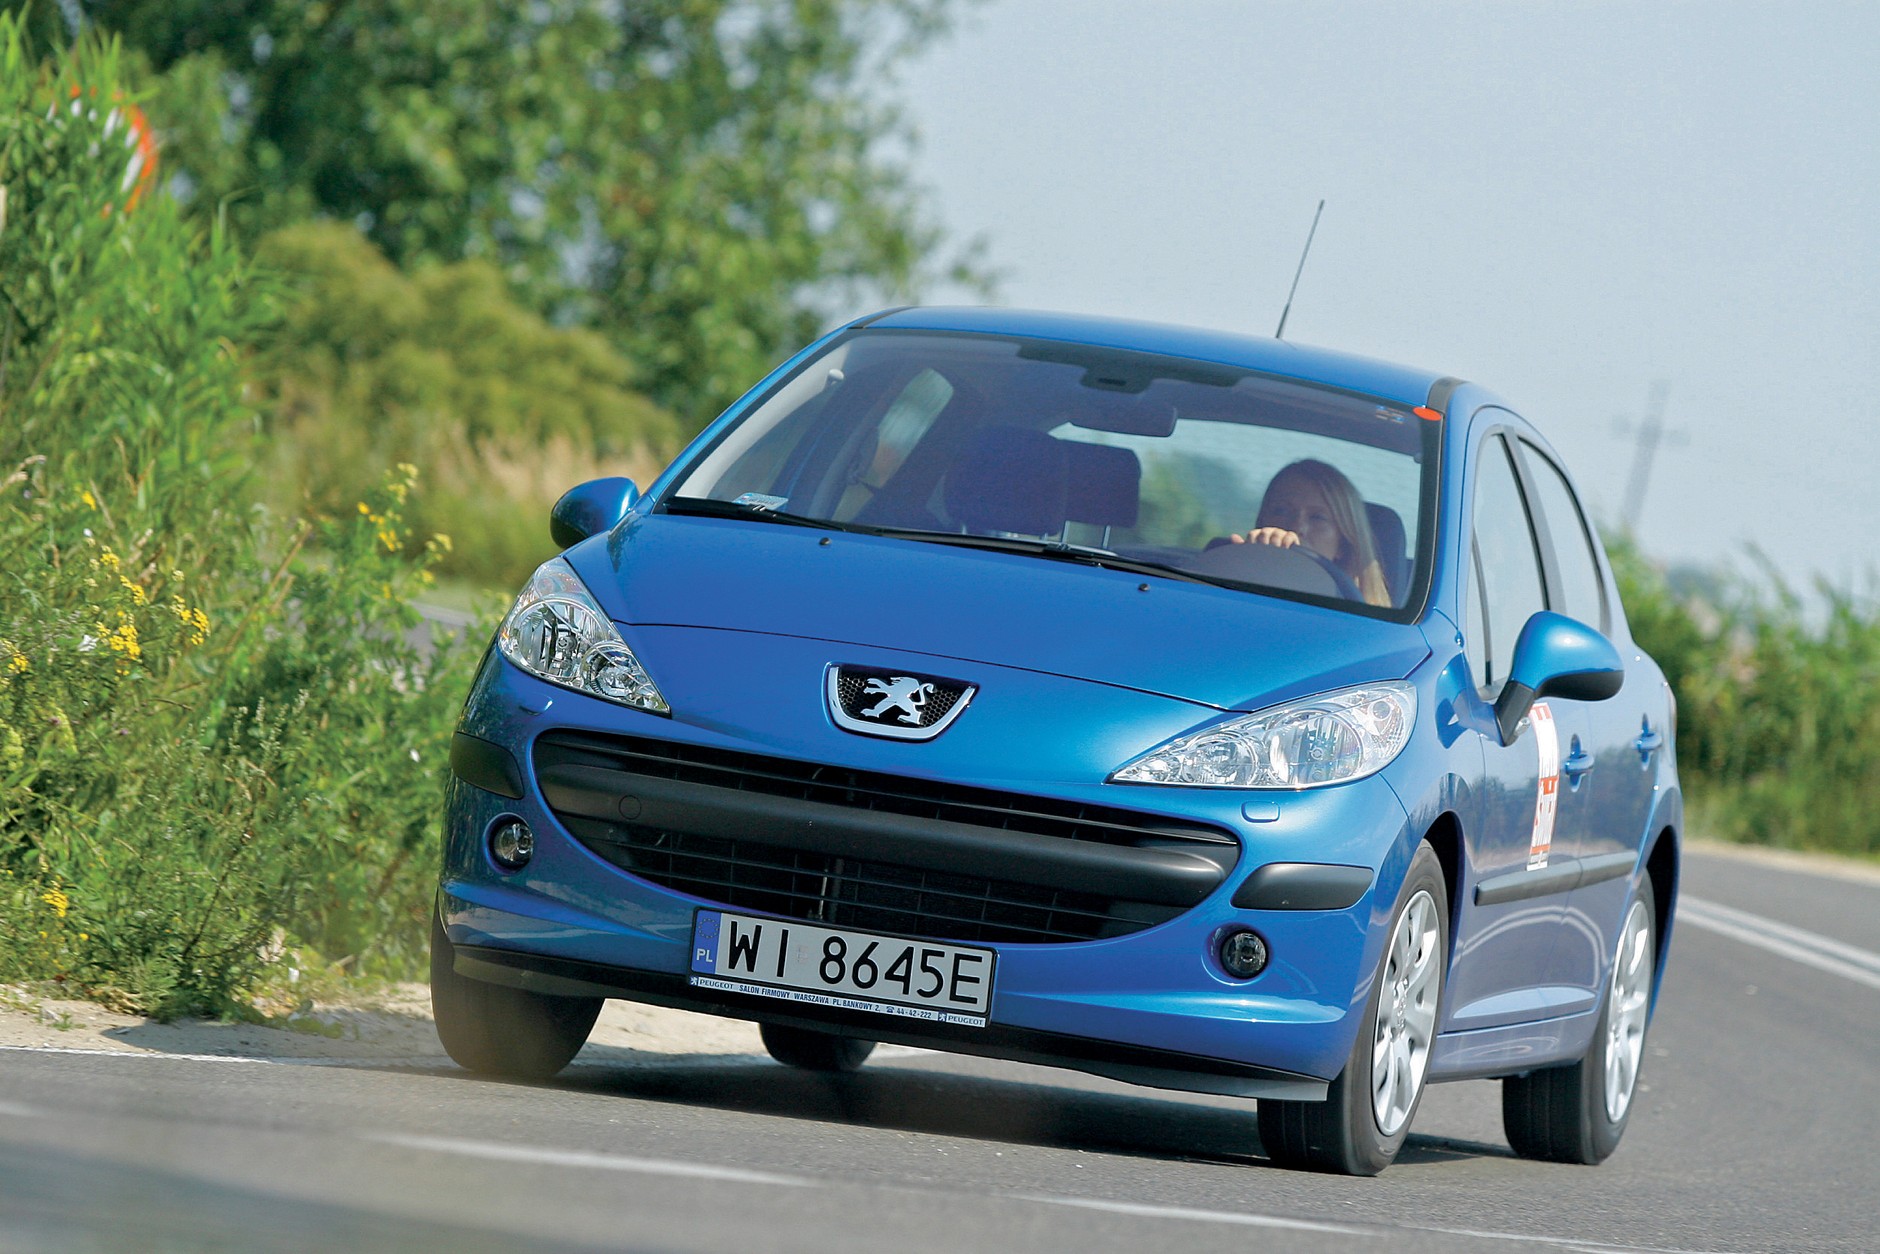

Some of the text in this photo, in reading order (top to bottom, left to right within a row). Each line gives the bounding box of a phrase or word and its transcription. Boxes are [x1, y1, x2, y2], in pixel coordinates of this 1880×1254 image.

[696, 948, 713, 963] PL
[728, 921, 983, 1004] WI 8645E
[699, 979, 734, 989] PEUGEOT
[739, 984, 760, 994] SALON
[761, 988, 790, 998] FIRMOWY
[793, 993, 829, 1004] WARSZAWA
[843, 1000, 872, 1010] BANKOWY
[948, 1015, 984, 1026] PEUGEOT
